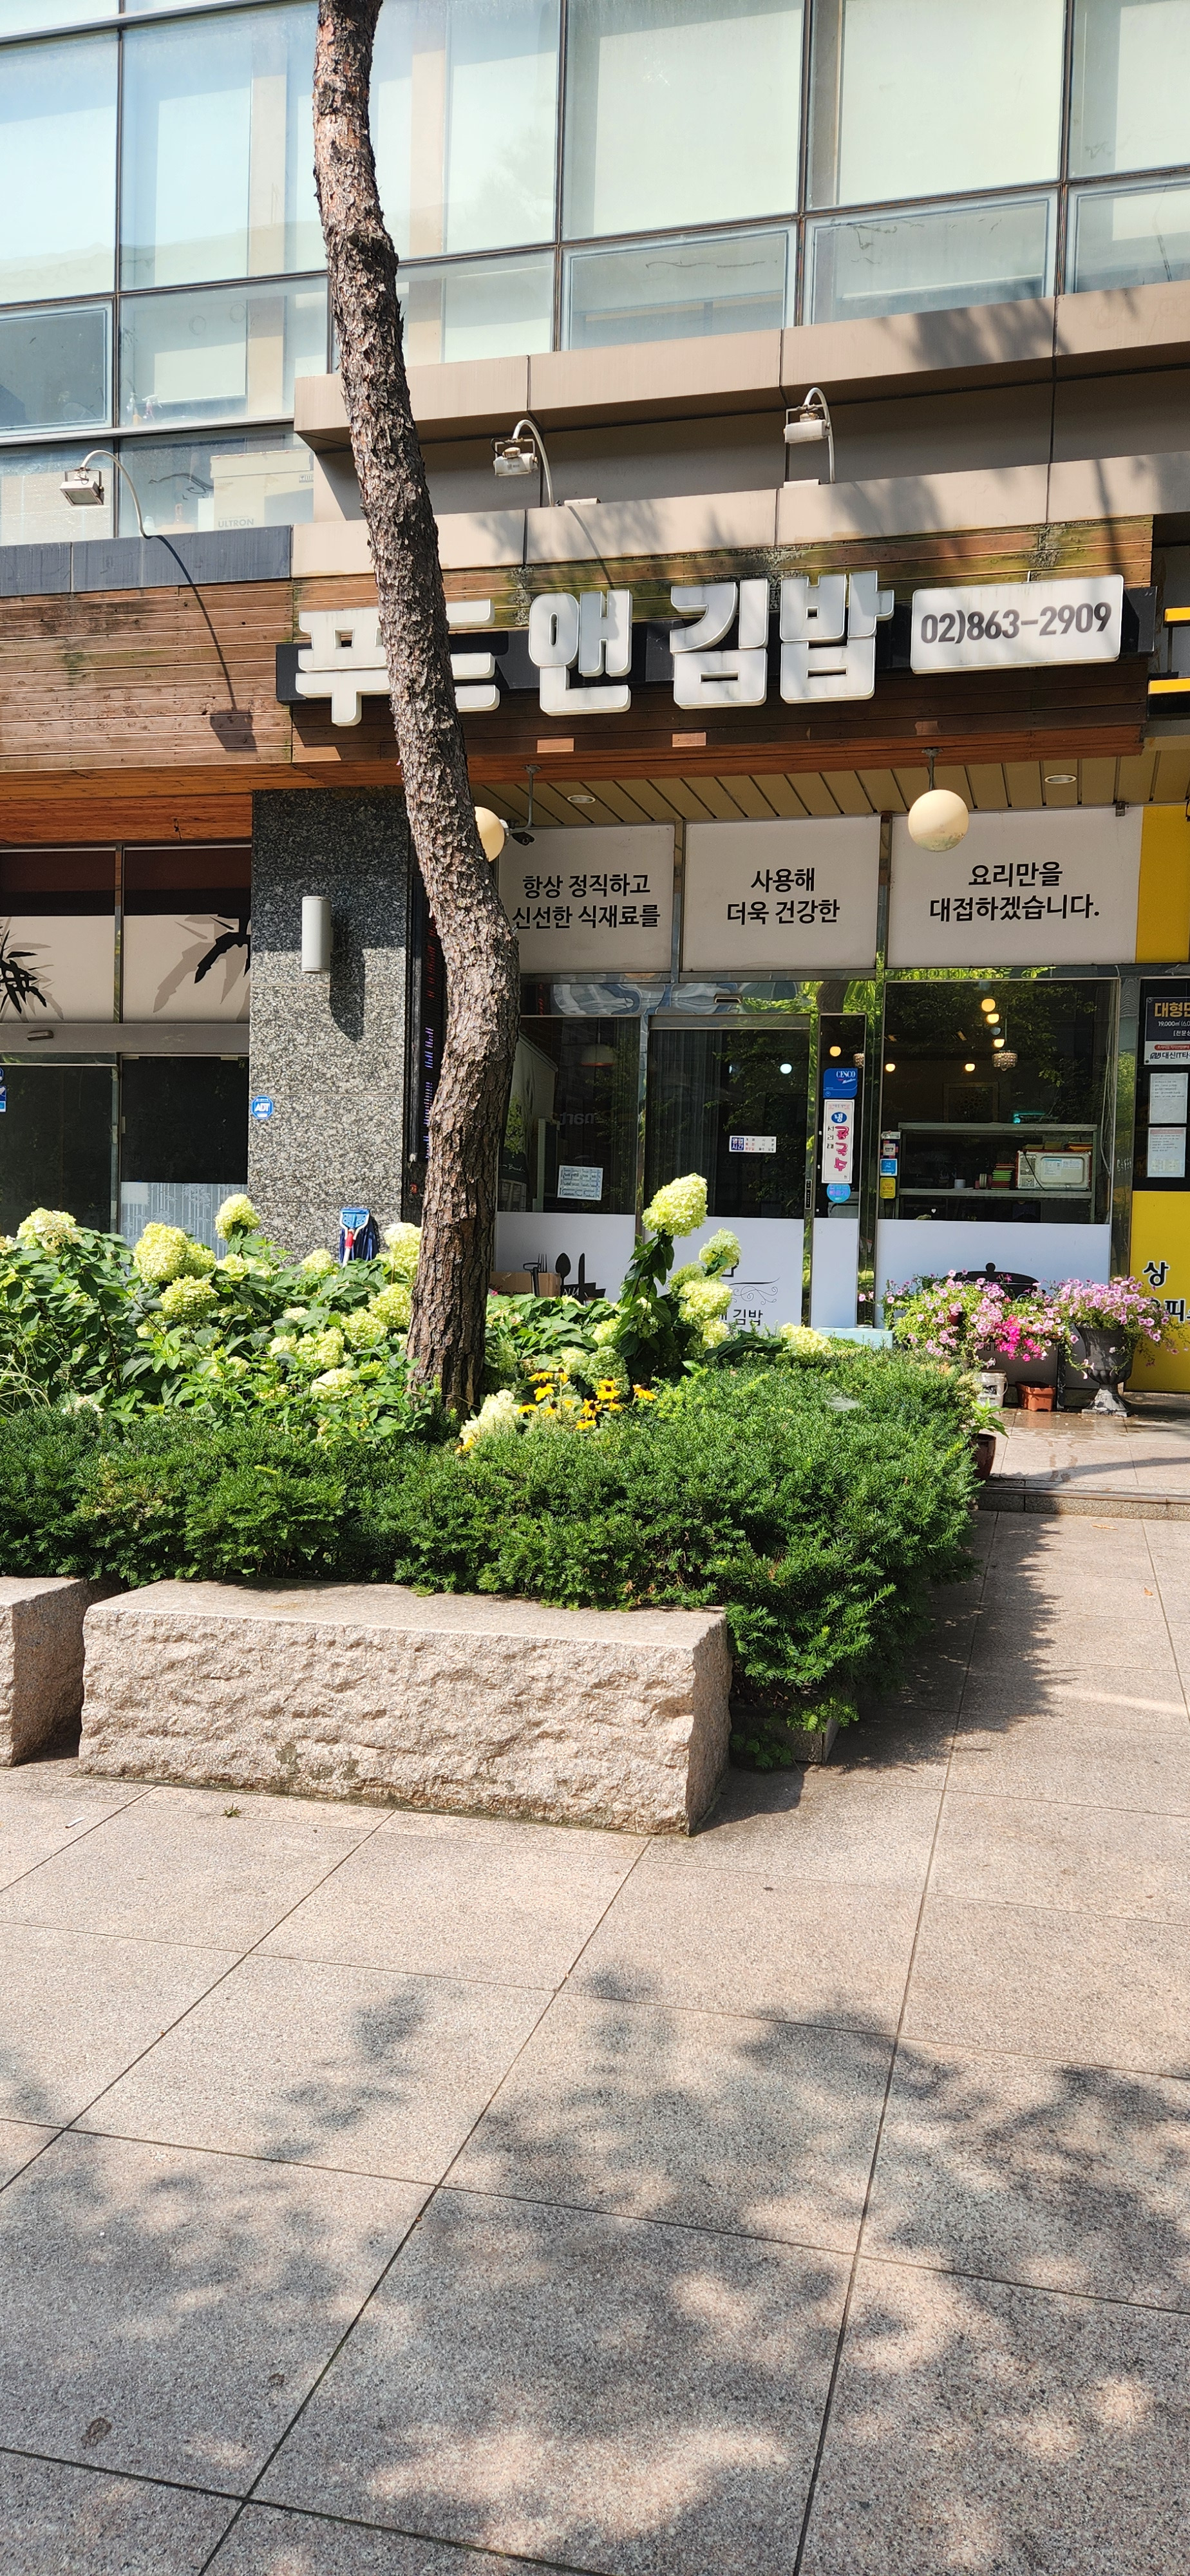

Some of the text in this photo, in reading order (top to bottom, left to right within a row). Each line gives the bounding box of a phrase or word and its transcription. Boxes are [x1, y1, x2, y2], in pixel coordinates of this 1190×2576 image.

[218, 518, 254, 528] ULTRON
[921, 602, 1111, 645] 02)863-2909
[529, 589, 633, 716] 앤
[670, 571, 894, 710] 김밥
[522, 873, 651, 899] 항상 정직하고
[751, 867, 815, 893] 사용해
[968, 861, 1063, 887] 요리만을
[512, 904, 661, 929] 신선한 식재료를
[727, 898, 840, 925] 더욱 건강한
[929, 893, 1100, 922] 대접하겠습니다.
[254, 1103, 270, 1112] ADT
[834, 1113, 843, 1122] 냉
[834, 1126, 849, 1172] 콩국수
[1143, 1262, 1169, 1287] 상
[733, 1309, 764, 1326] 김밥
